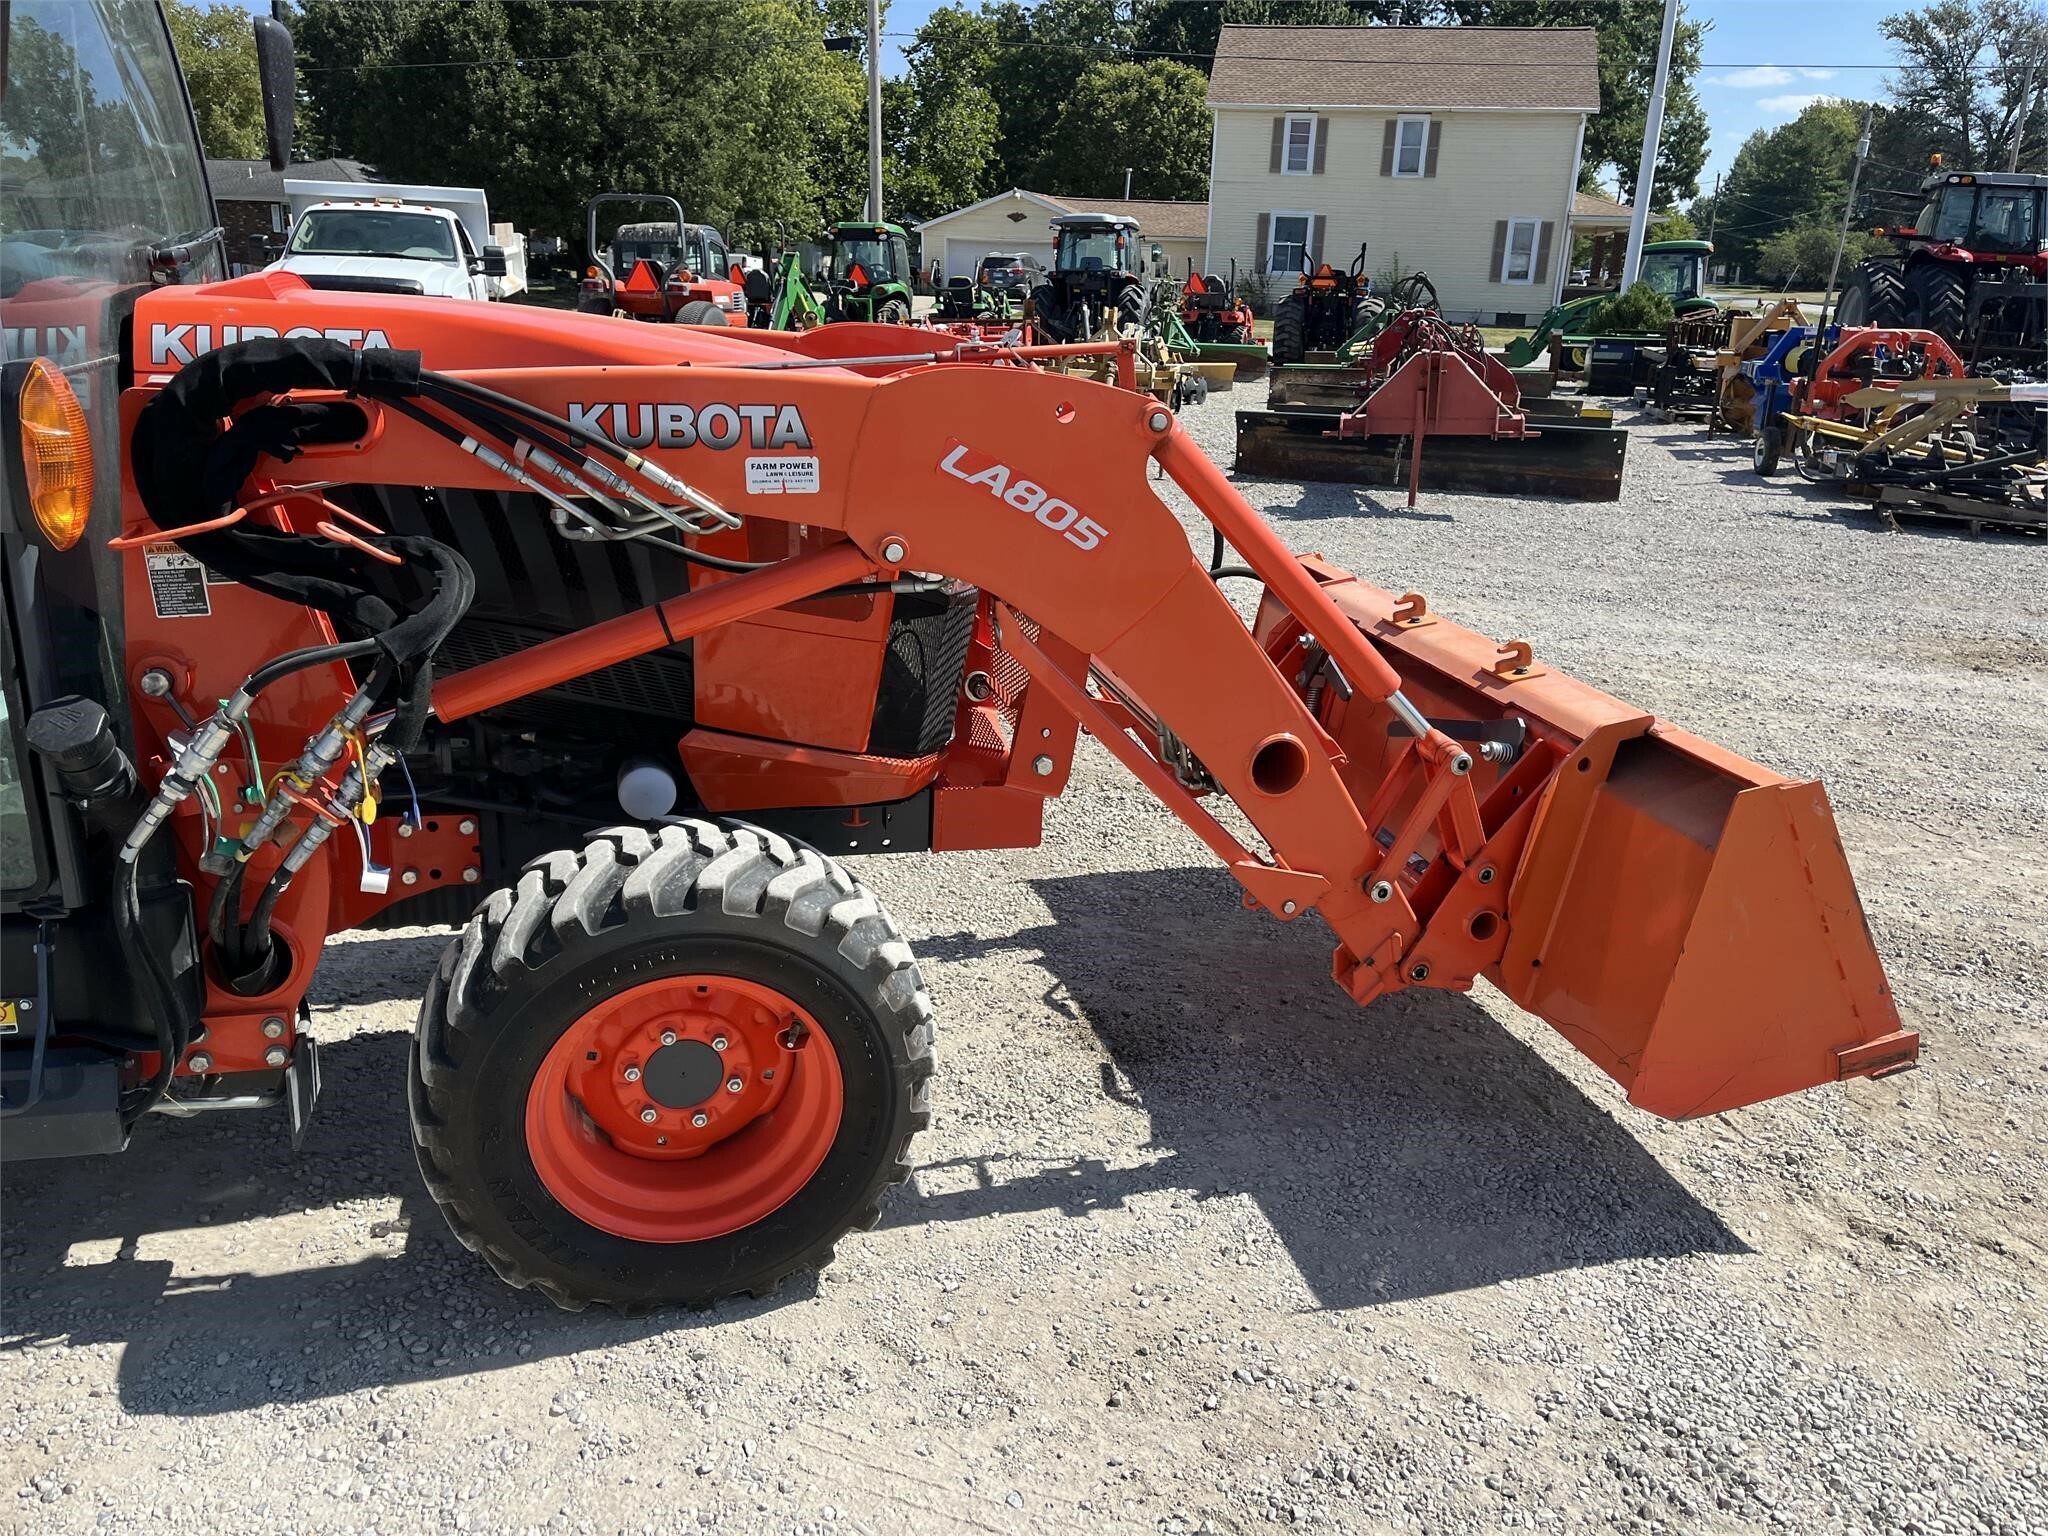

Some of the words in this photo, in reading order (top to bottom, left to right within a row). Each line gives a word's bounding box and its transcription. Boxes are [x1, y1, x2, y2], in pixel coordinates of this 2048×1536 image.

[151, 323, 394, 364] KUTA
[568, 402, 813, 449] KUBOTA
[780, 462, 813, 470] POWER
[940, 444, 1109, 550] LA805
